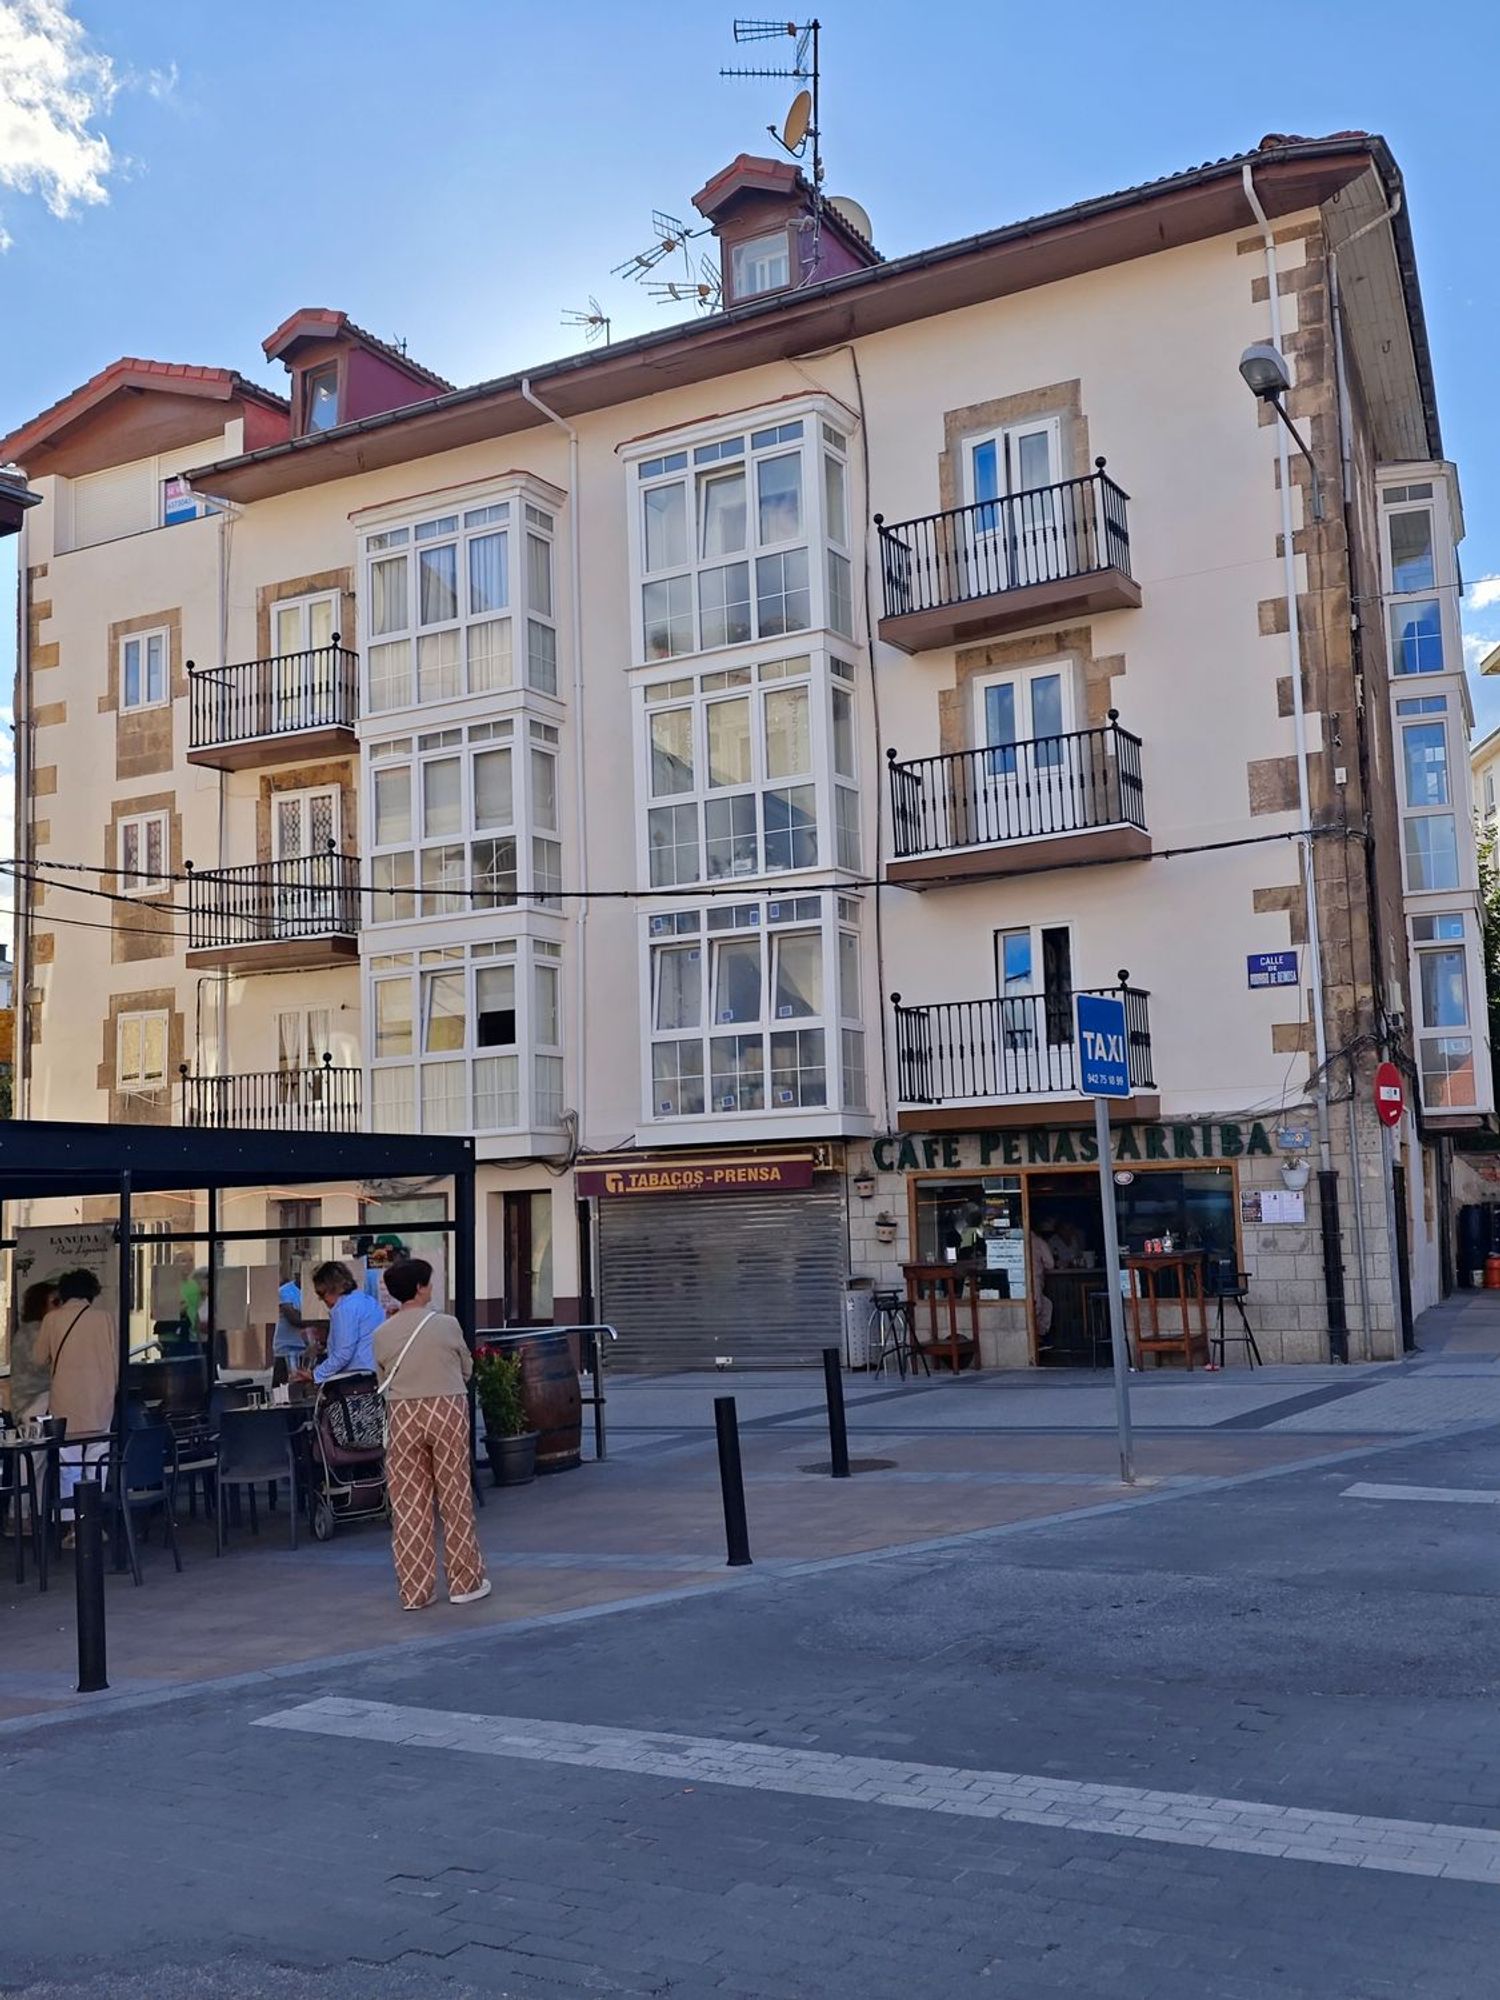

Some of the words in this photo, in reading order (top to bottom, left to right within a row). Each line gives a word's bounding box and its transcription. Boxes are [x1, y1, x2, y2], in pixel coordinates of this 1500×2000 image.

[1260, 955, 1284, 966] CALLE
[1082, 1031, 1124, 1063] TAXI
[1087, 1073, 1099, 1083] 942
[873, 1136, 962, 1171] CAFE
[1115, 1122, 1273, 1161] ARRIBA
[629, 1167, 781, 1188] TABACOS-PRENSA
